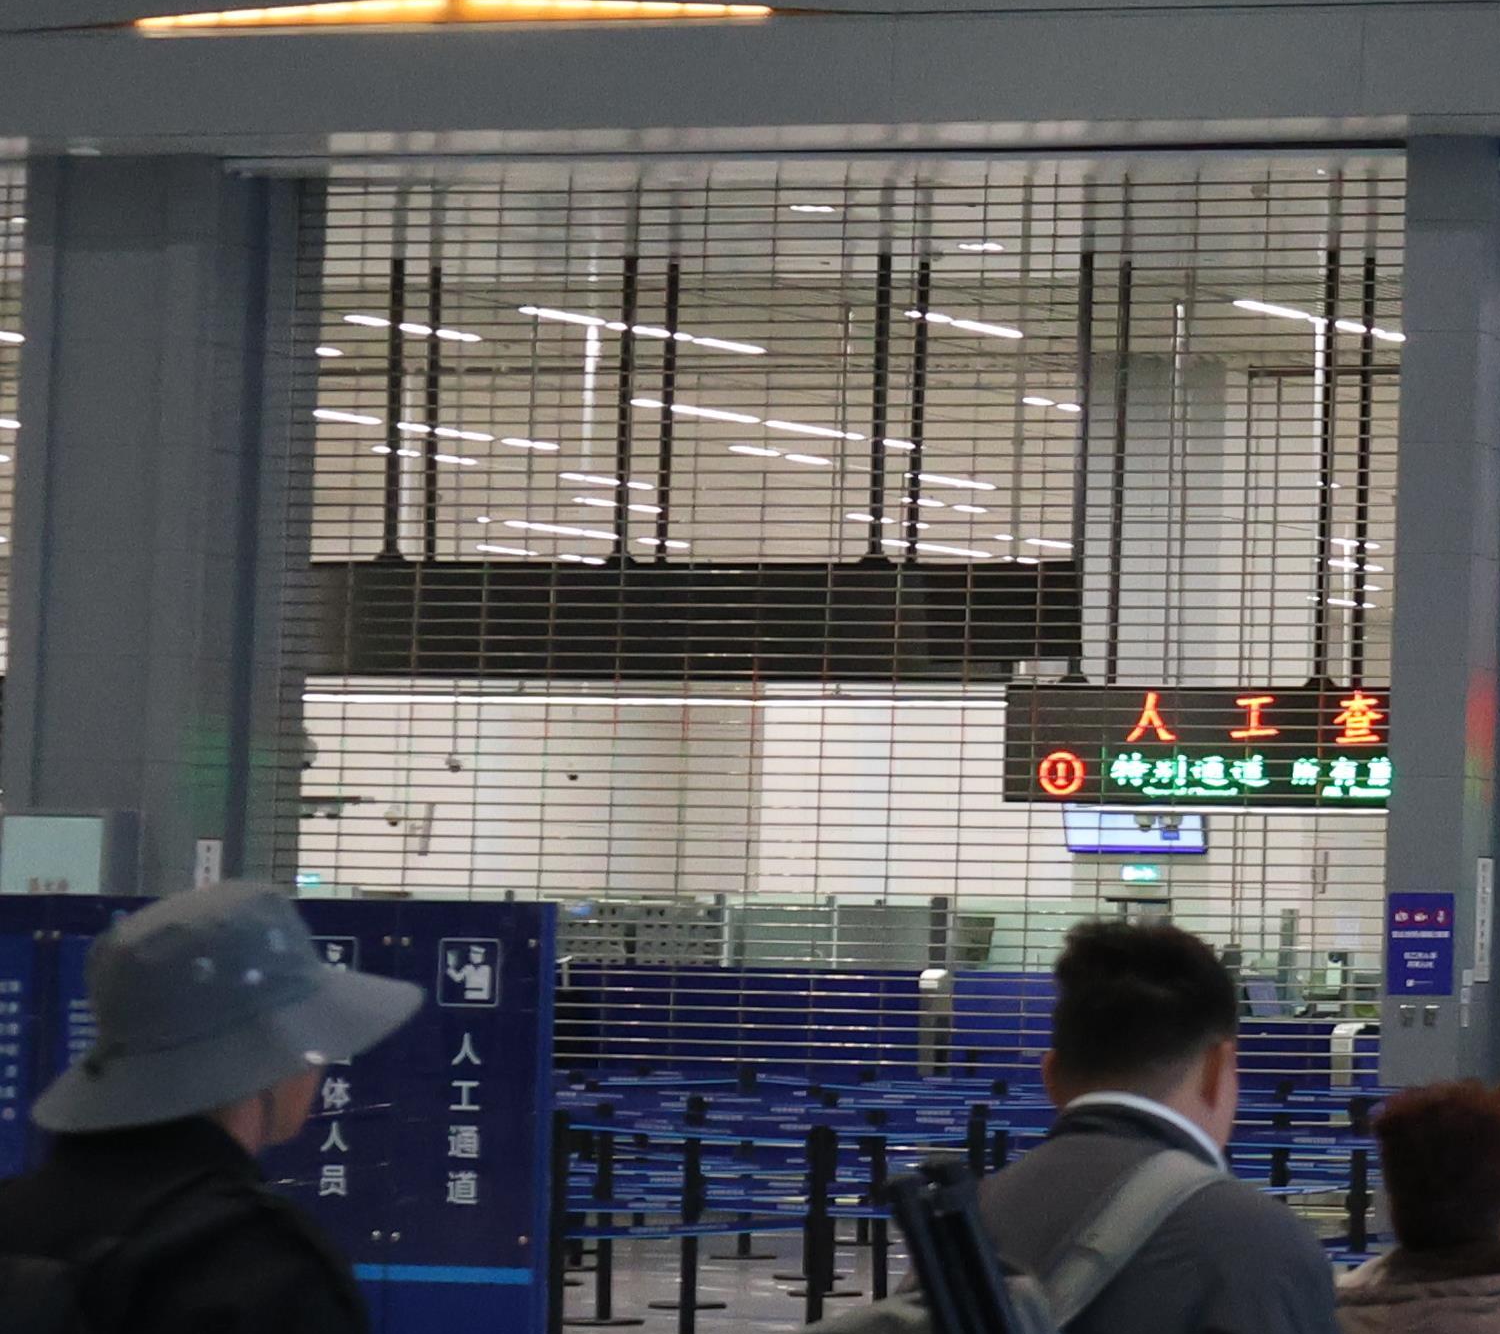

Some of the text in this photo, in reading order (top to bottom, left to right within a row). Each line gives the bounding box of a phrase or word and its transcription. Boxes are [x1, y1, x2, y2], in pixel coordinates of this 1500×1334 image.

[319, 1052, 352, 1197] 体人员
[445, 1032, 482, 1205] 人工通道
